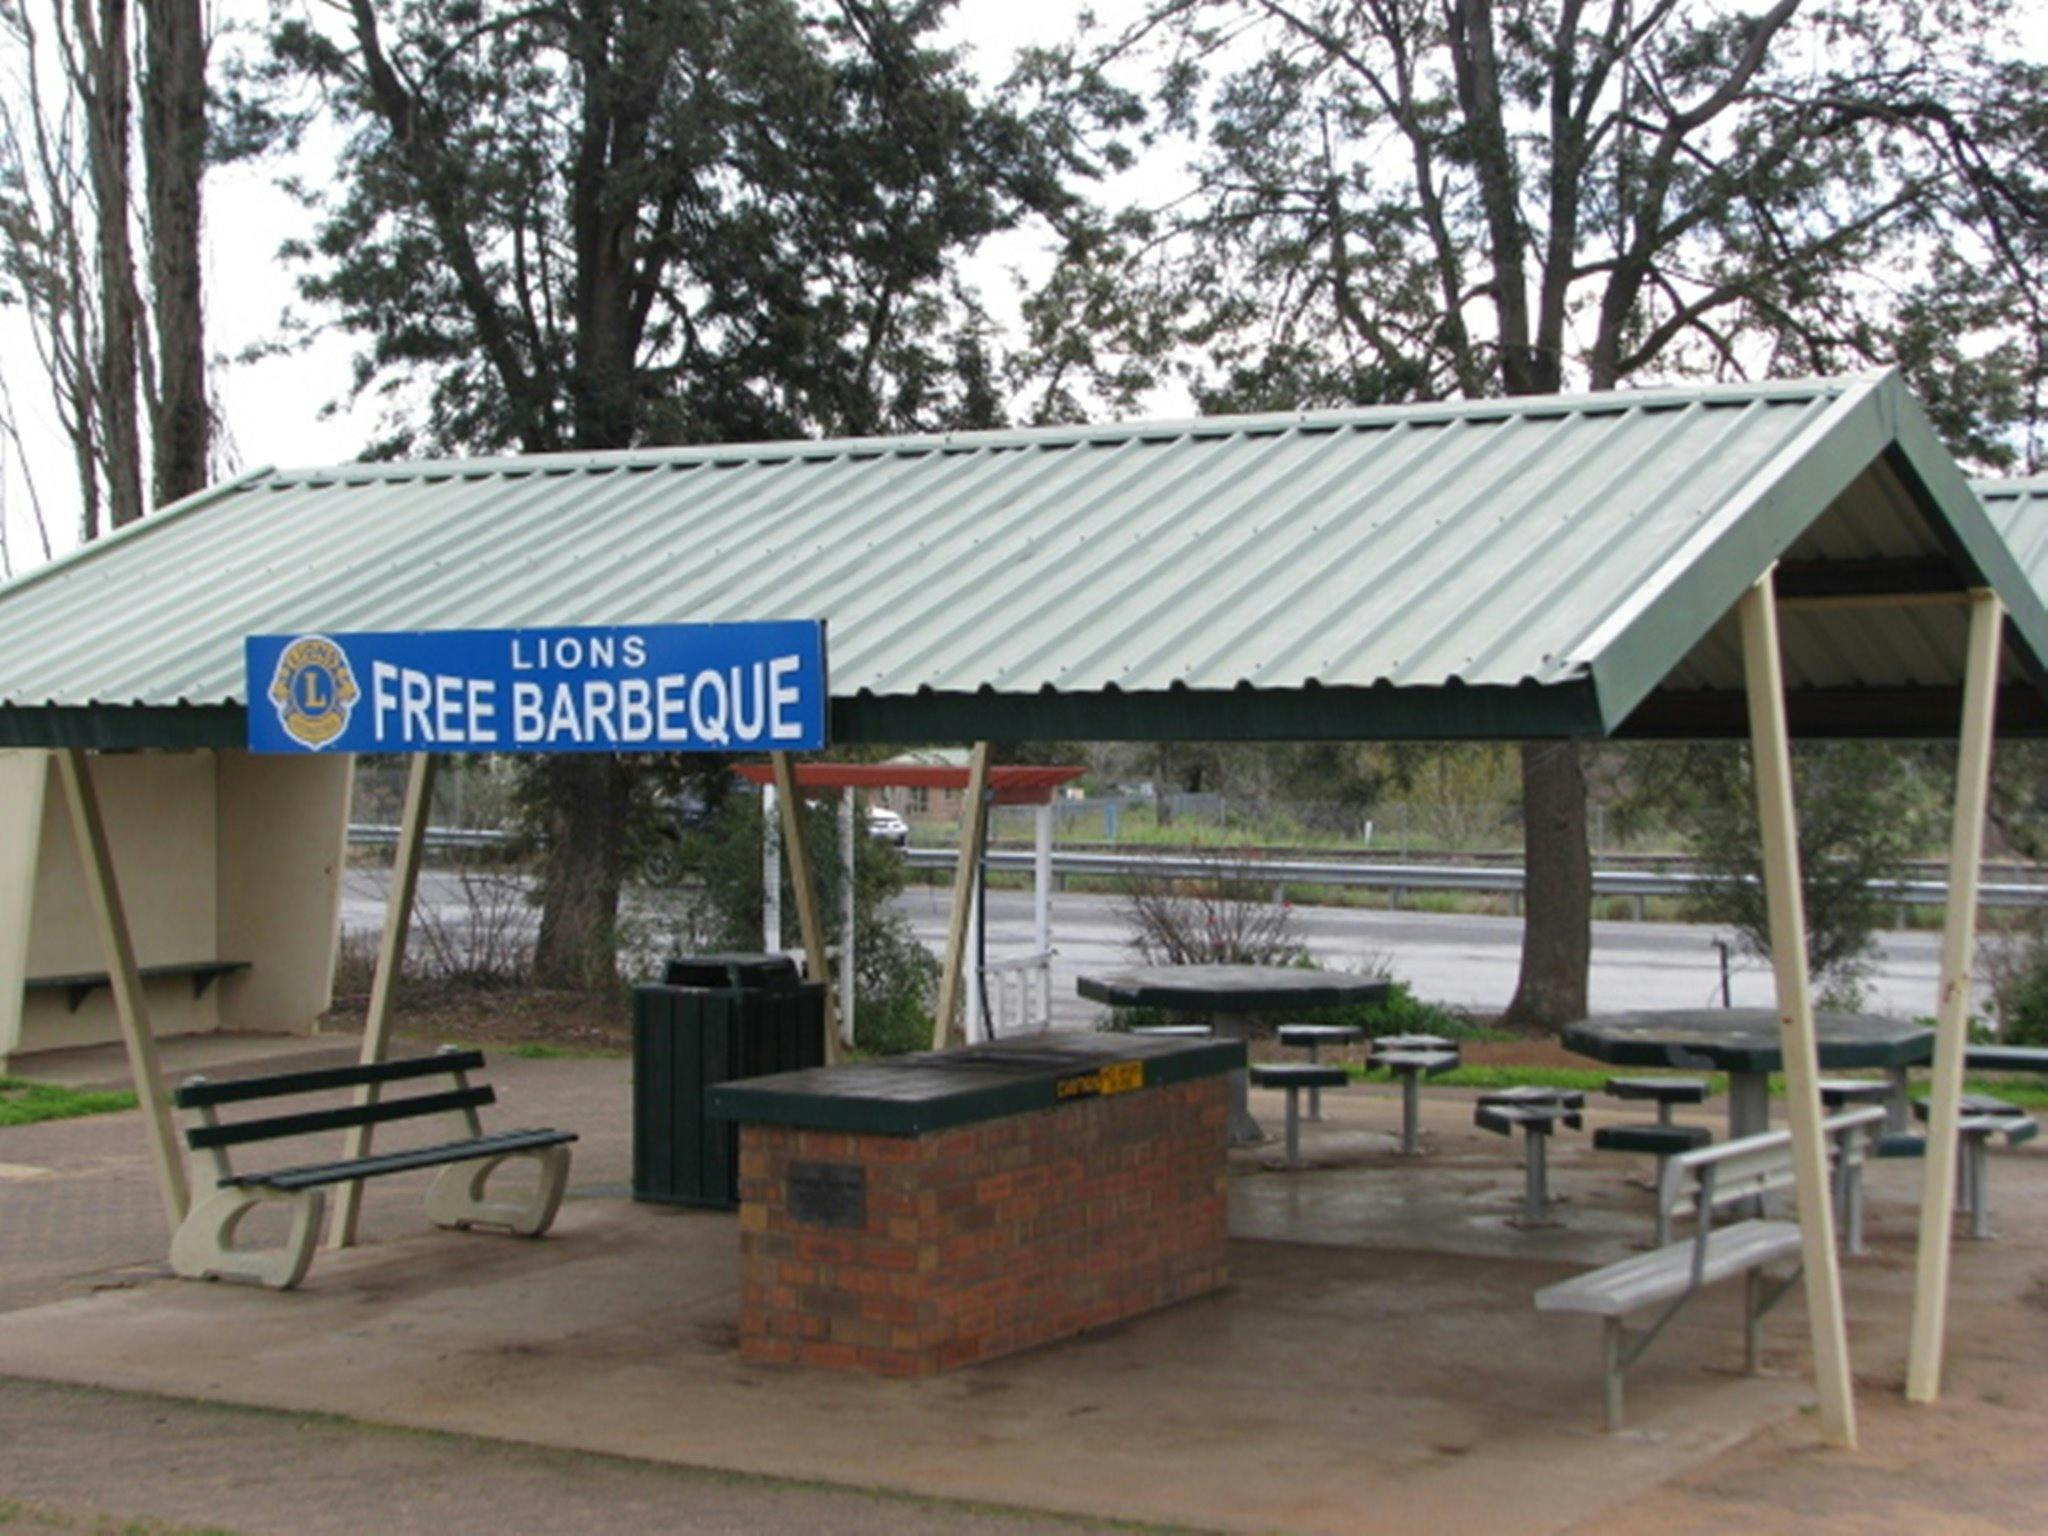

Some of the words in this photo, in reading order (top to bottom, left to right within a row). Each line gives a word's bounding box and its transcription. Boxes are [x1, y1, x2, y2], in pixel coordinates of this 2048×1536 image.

[512, 635, 646, 669] LIONS
[304, 672, 326, 707] L
[372, 659, 497, 742] FREE
[512, 654, 803, 745] BARBEQUE
